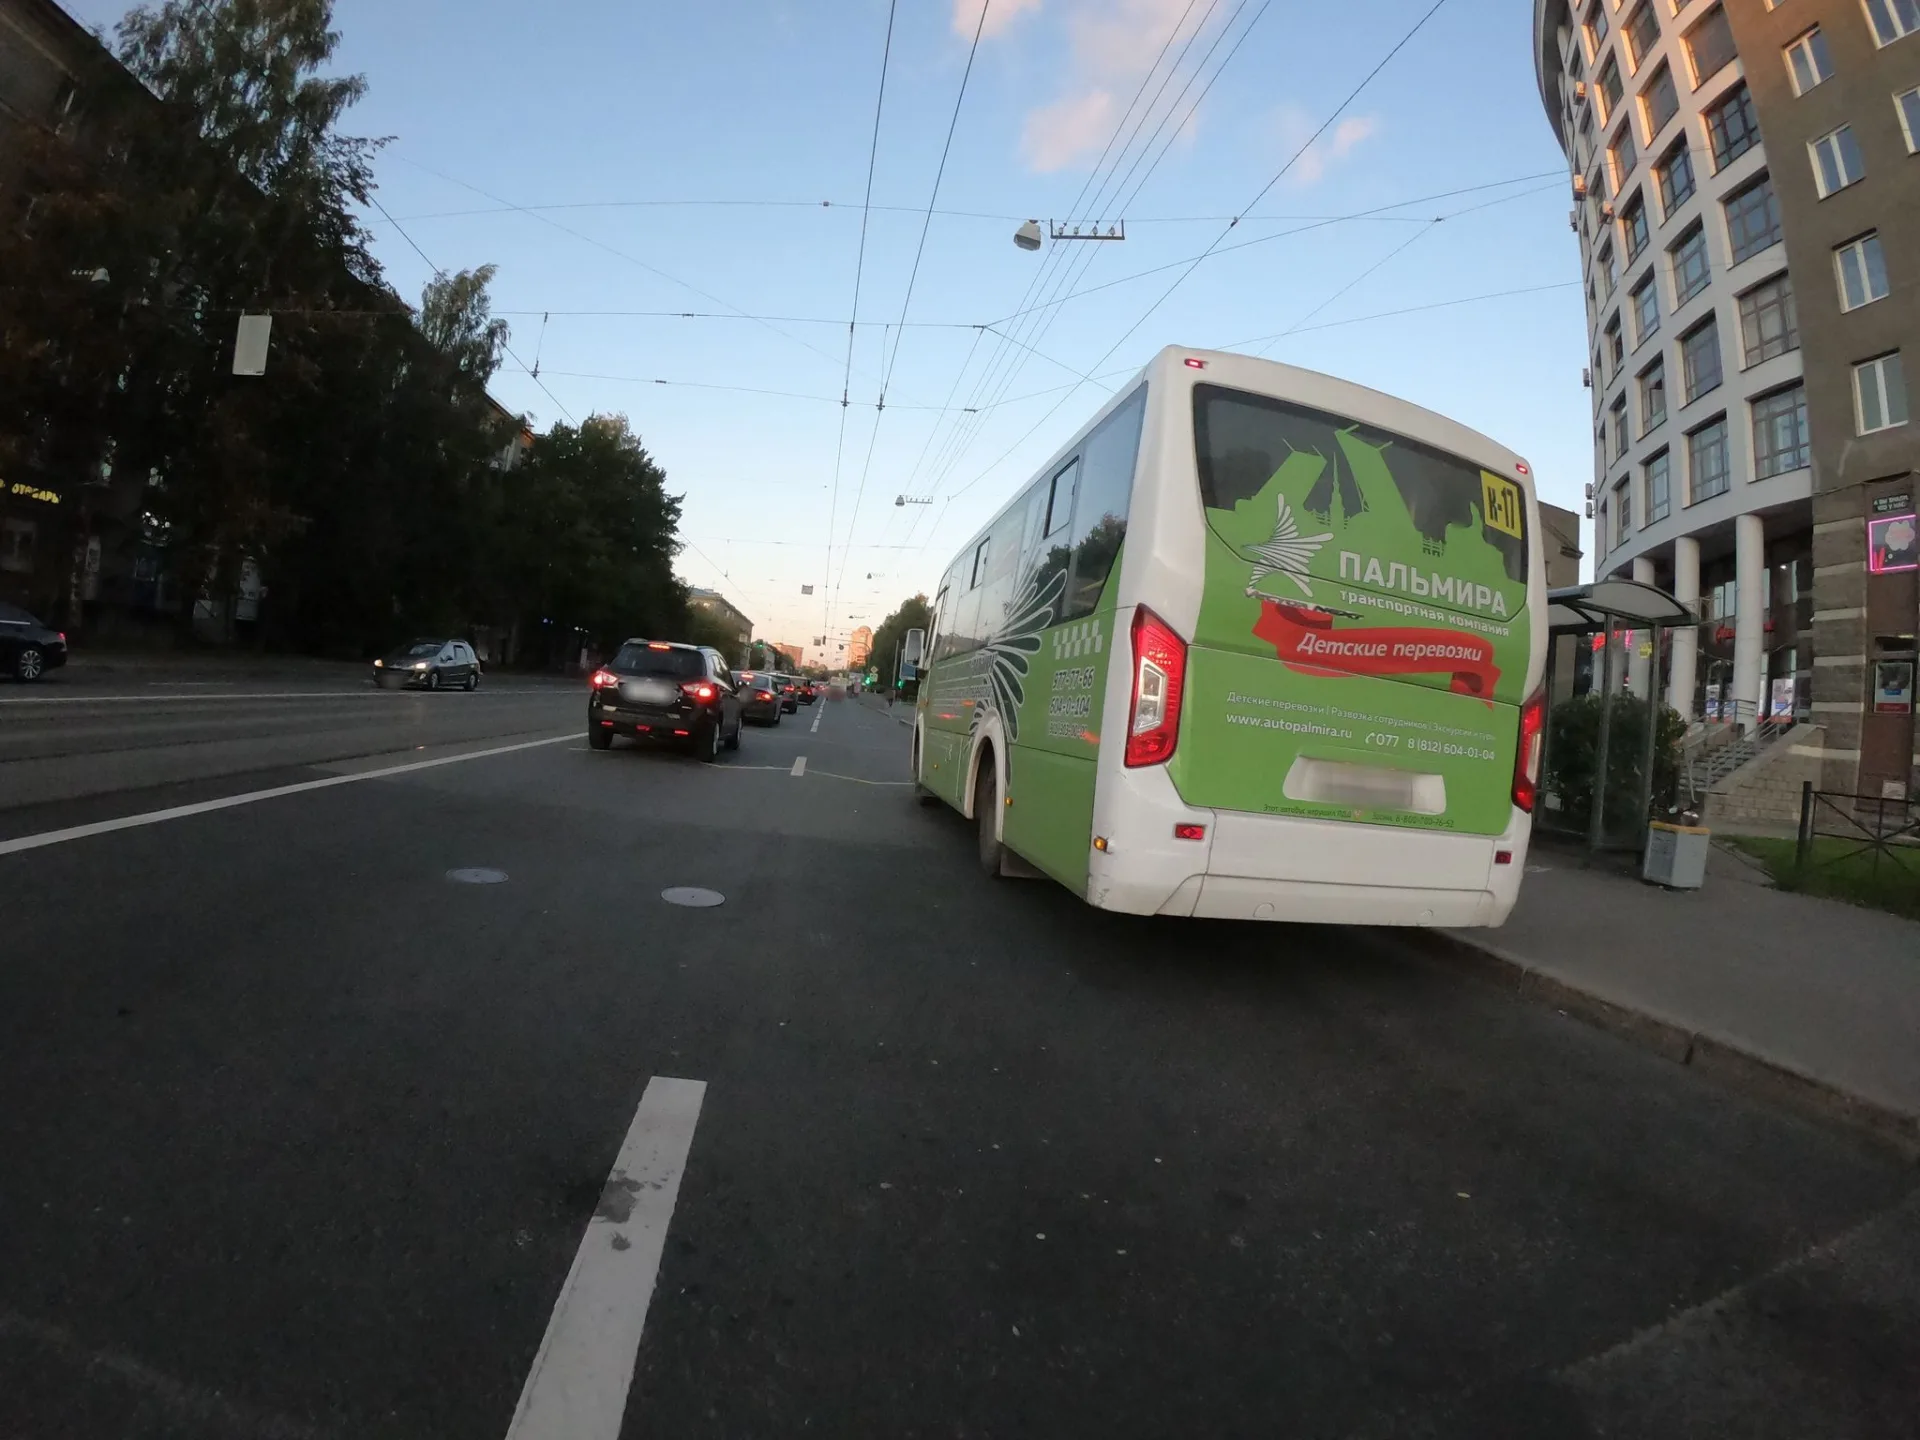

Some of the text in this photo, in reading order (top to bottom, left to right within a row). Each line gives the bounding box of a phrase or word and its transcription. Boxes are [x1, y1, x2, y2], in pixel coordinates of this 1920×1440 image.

[1339, 550, 1508, 617] ПАЛЬМИРА
[1340, 590, 1445, 622] транспортная
[1448, 614, 1510, 637] компания
[1297, 632, 1482, 662] Детские перевозки
[1227, 692, 1271, 707] Детские
[1272, 700, 1325, 713] перевозки
[1331, 706, 1373, 722] Развозка
[1226, 713, 1353, 739] www.autopalmira.ru
[1376, 733, 1496, 761] 077 8 (812) 604-01-04
